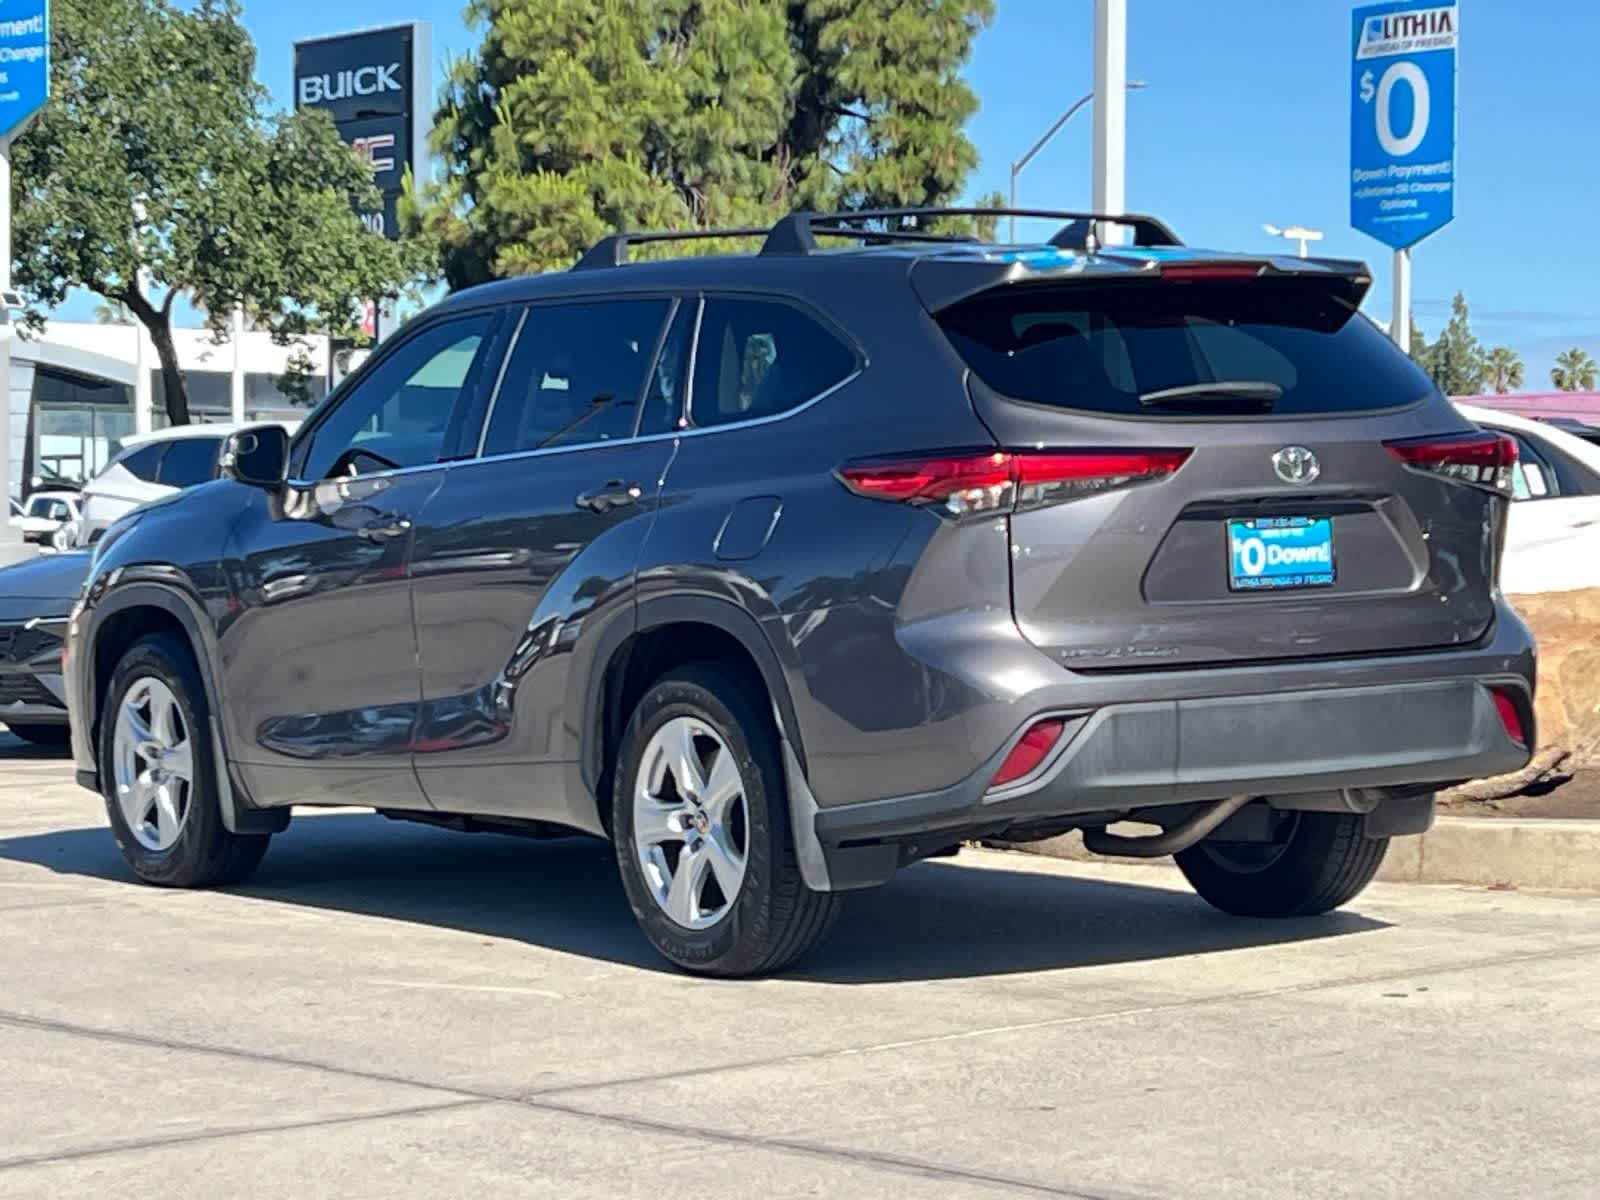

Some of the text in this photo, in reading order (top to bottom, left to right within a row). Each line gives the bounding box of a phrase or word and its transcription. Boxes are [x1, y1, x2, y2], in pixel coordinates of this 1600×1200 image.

[1384, 10, 1452, 39] LITHIA
[299, 62, 402, 104] BUICK
[1267, 542, 1329, 566] Down!
